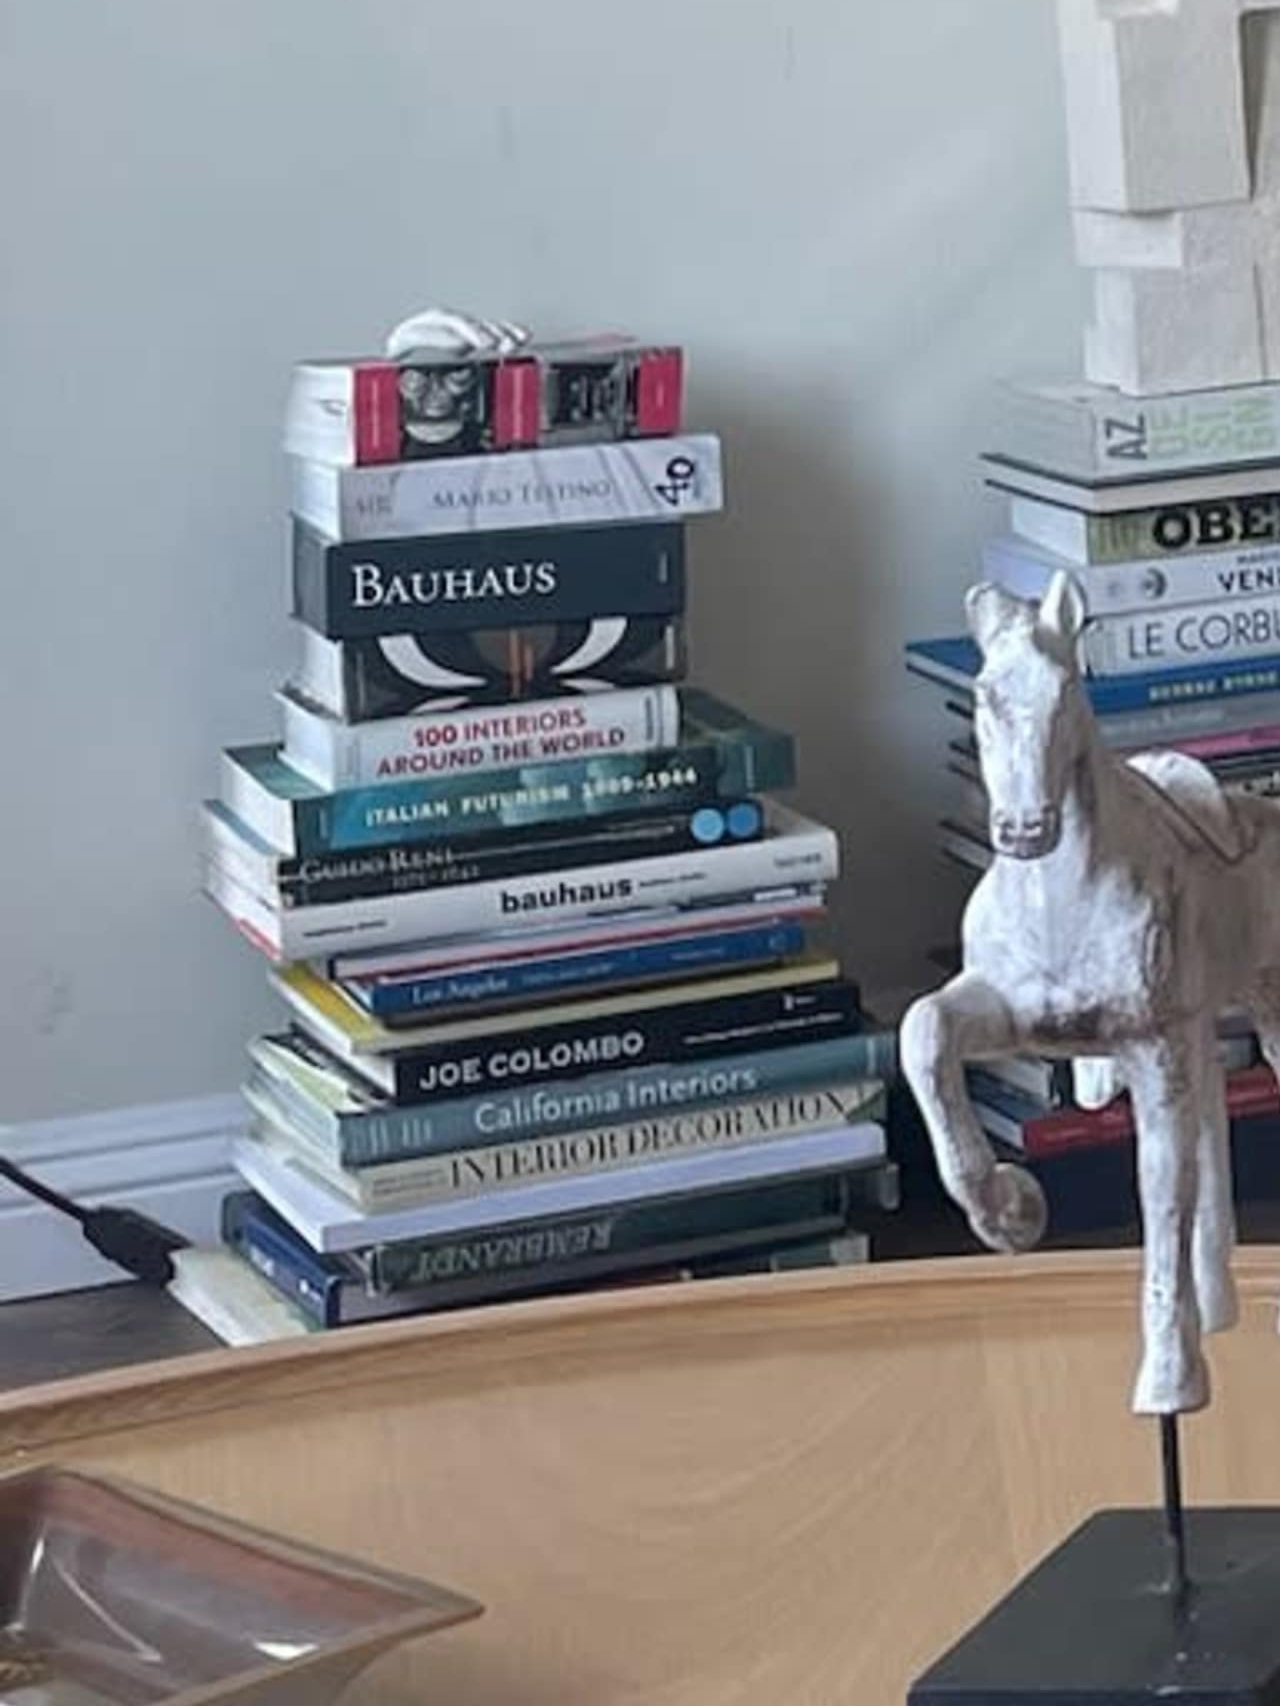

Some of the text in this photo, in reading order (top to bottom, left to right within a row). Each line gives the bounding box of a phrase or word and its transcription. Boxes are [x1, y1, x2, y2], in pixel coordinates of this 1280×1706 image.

[1104, 413, 1148, 462] AZ
[432, 482, 512, 509] MARIO
[351, 560, 557, 609] BAUHAUS
[1127, 622, 1164, 661] LE
[375, 726, 626, 777] AROUND THE WORLD
[413, 707, 587, 748] 100 INTERIORS
[363, 800, 449, 828] ITALIAN
[460, 784, 571, 816] FUTURISM
[501, 876, 633, 914] bauhaus
[419, 1058, 482, 1092] JOE
[488, 1030, 646, 1078] COLOMBO
[474, 1067, 757, 1135] California Interiors
[449, 1132, 619, 1189] INTERIOR
[624, 1090, 852, 1156] DECORATION
[413, 1218, 615, 1280] REMBRANDT
